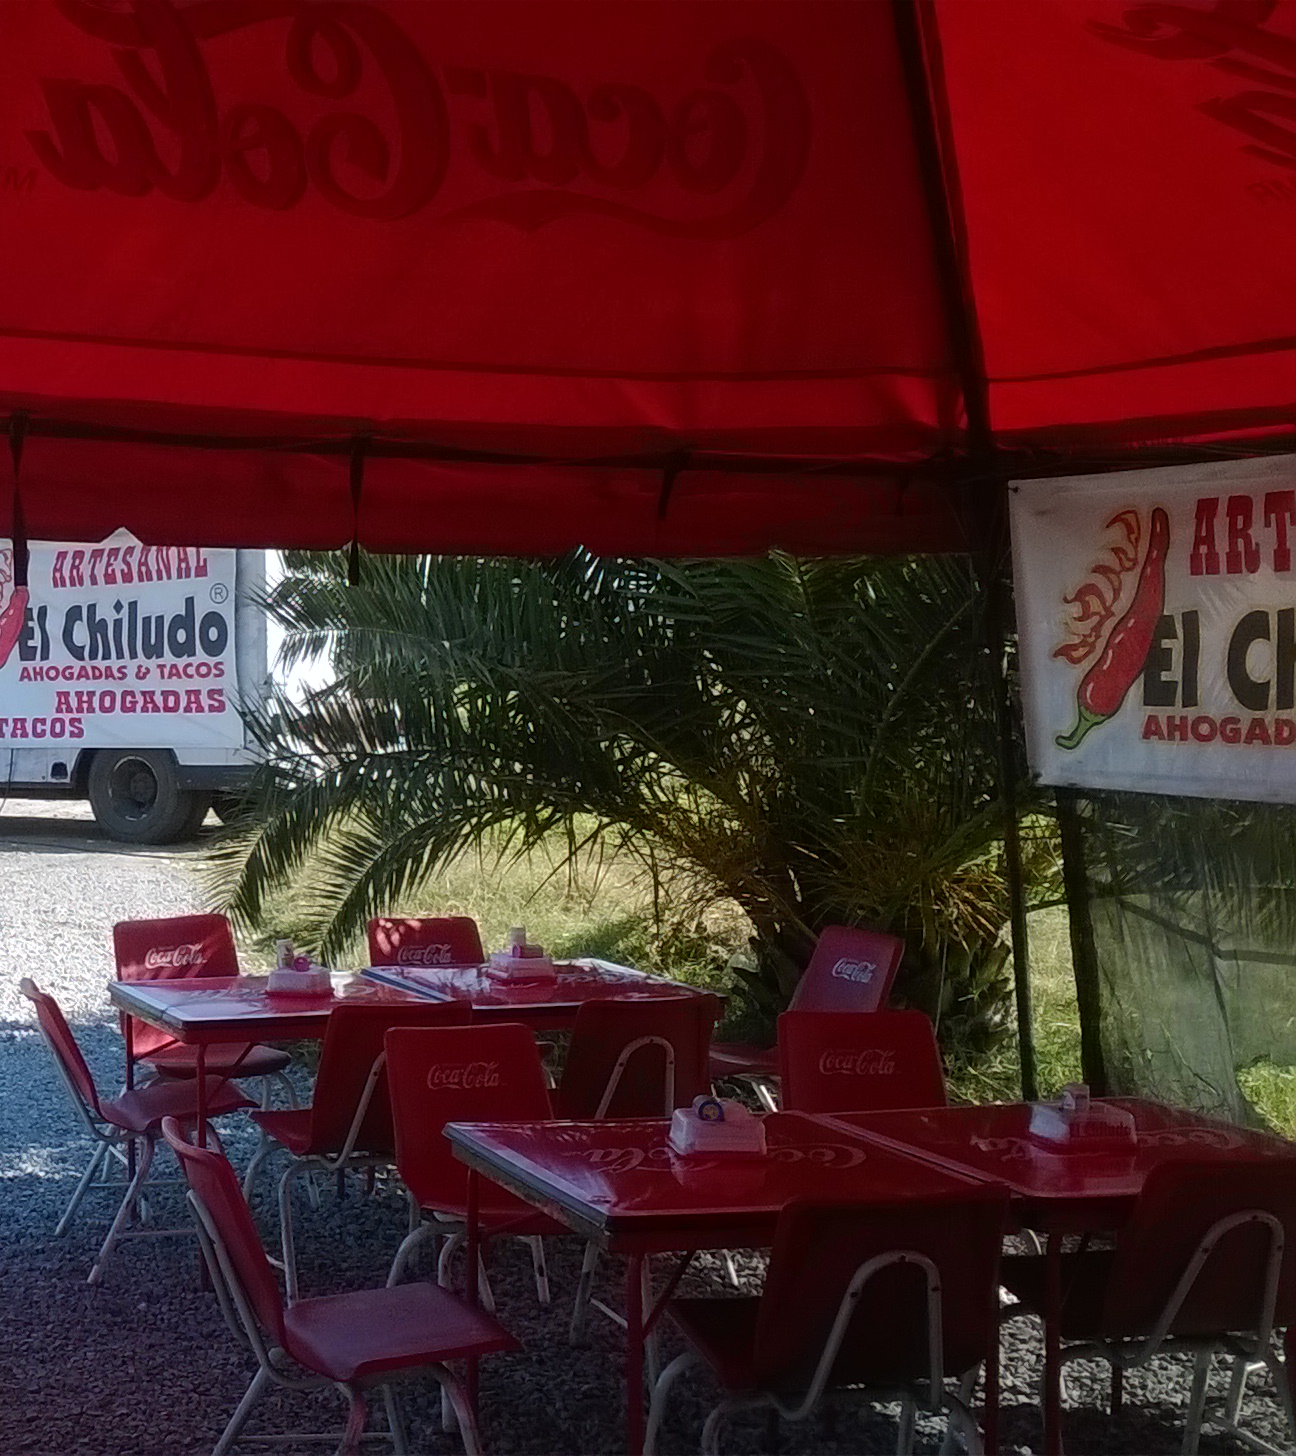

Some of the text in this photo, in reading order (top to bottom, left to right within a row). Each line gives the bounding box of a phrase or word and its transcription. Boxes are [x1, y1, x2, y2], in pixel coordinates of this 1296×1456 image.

[52, 546, 209, 588] ARTESANAL
[18, 596, 229, 662] El Chiludo
[19, 661, 225, 682] AHOGADAS & TACOS
[1143, 609, 1199, 709] El
[55, 687, 227, 714] AHOGADAS
